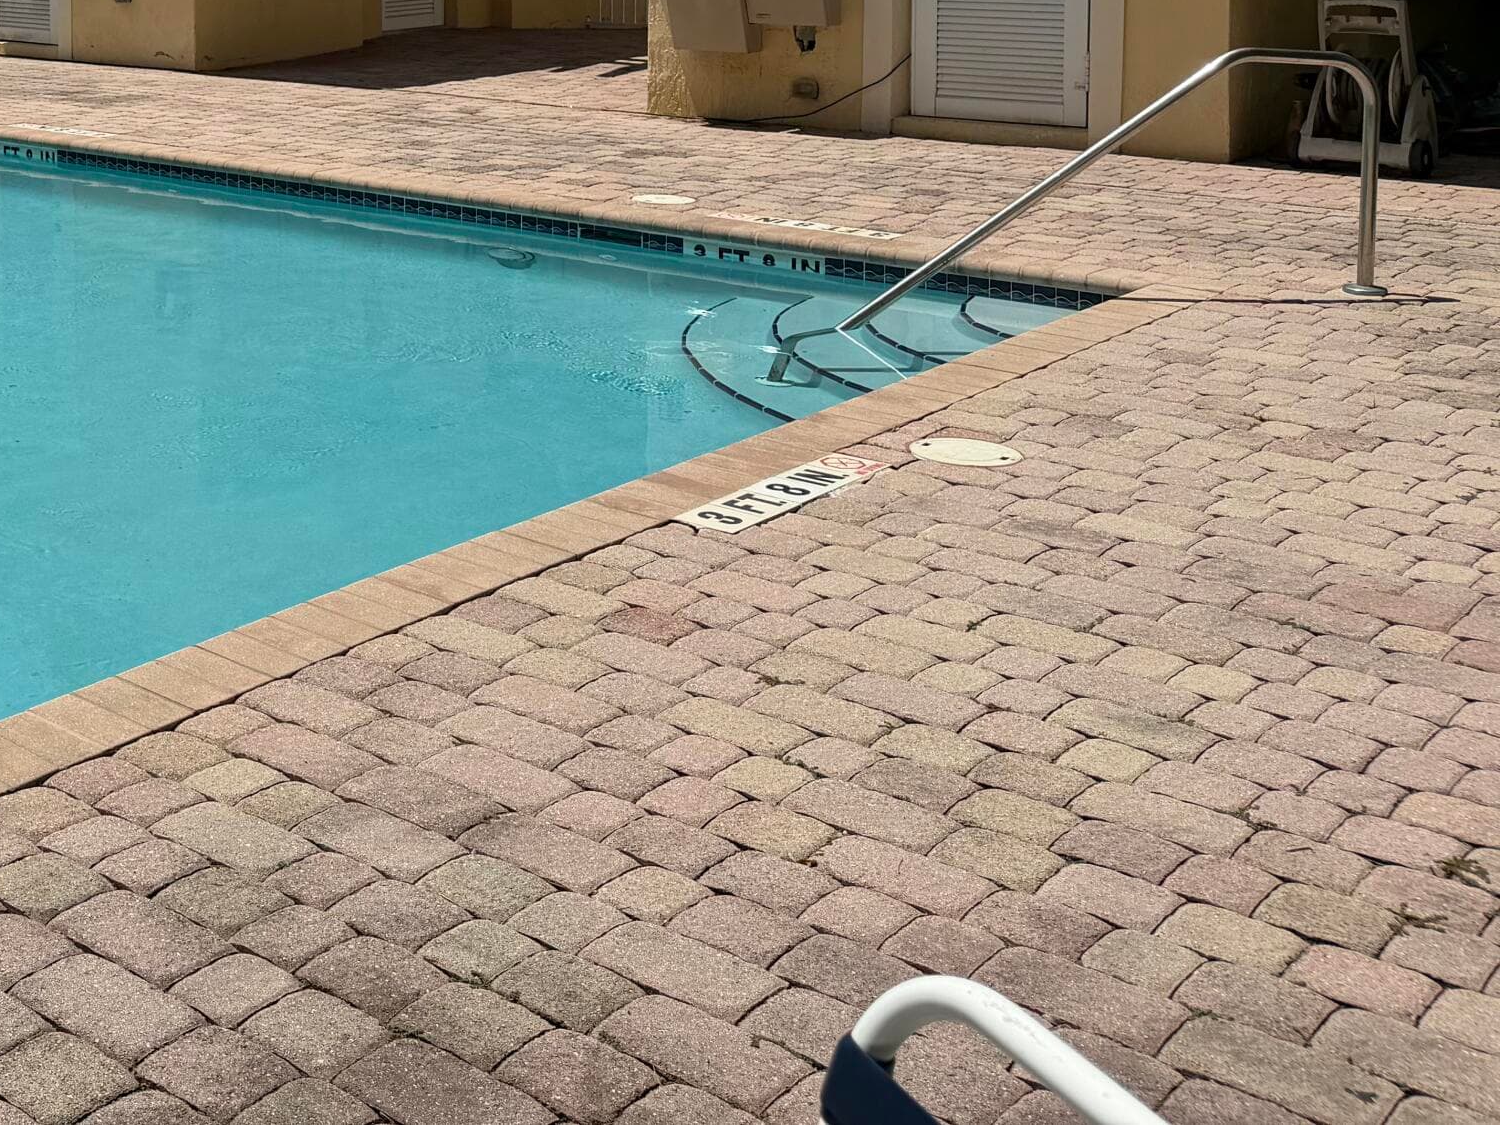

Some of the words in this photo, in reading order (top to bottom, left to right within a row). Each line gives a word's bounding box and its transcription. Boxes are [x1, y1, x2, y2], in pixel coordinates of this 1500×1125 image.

[718, 246, 750, 262] FT
[791, 257, 821, 273] IN
[786, 468, 850, 487] IN.
[765, 483, 811, 496] 8
[721, 492, 787, 514] FT.
[697, 510, 743, 525] 3
